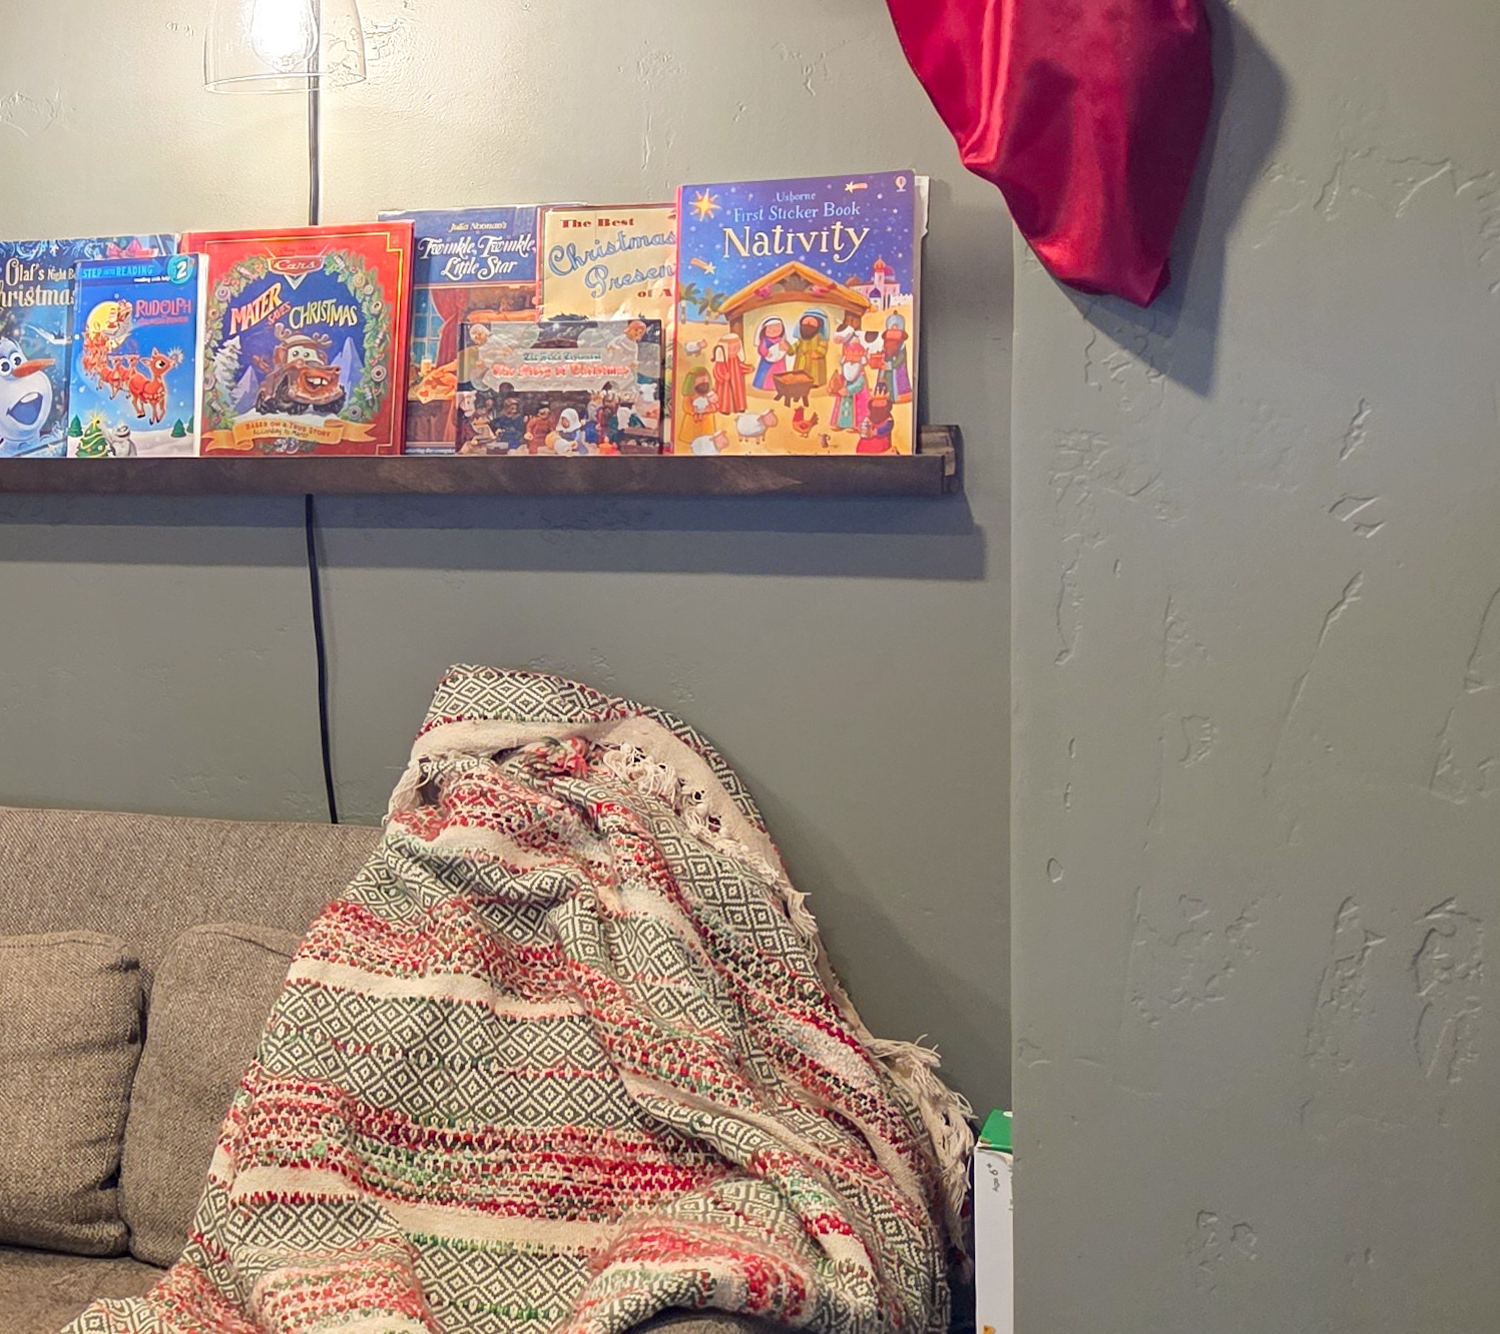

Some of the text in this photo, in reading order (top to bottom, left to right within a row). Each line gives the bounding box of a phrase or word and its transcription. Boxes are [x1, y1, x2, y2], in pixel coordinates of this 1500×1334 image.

[776, 190, 816, 203] Usborne
[734, 201, 861, 222] First Sticker Book
[448, 223, 469, 232] Julia
[560, 217, 634, 228] The Best
[418, 233, 536, 260] Twinkle, Twinkle,
[722, 220, 870, 263] Nativity
[548, 230, 676, 276] Christmas
[5, 257, 45, 286] Olaf's
[83, 268, 102, 278] STEP
[116, 265, 153, 276] READING
[176, 261, 187, 279] 2
[273, 260, 315, 270] Cars
[440, 255, 518, 281] Little Star
[584, 264, 676, 298] Presen
[637, 289, 652, 297] of
[135, 297, 192, 317] RUDOLPH
[229, 282, 283, 335] MATER
[289, 298, 358, 329] CHRISTMAS
[992, 1178, 1001, 1193] Age
